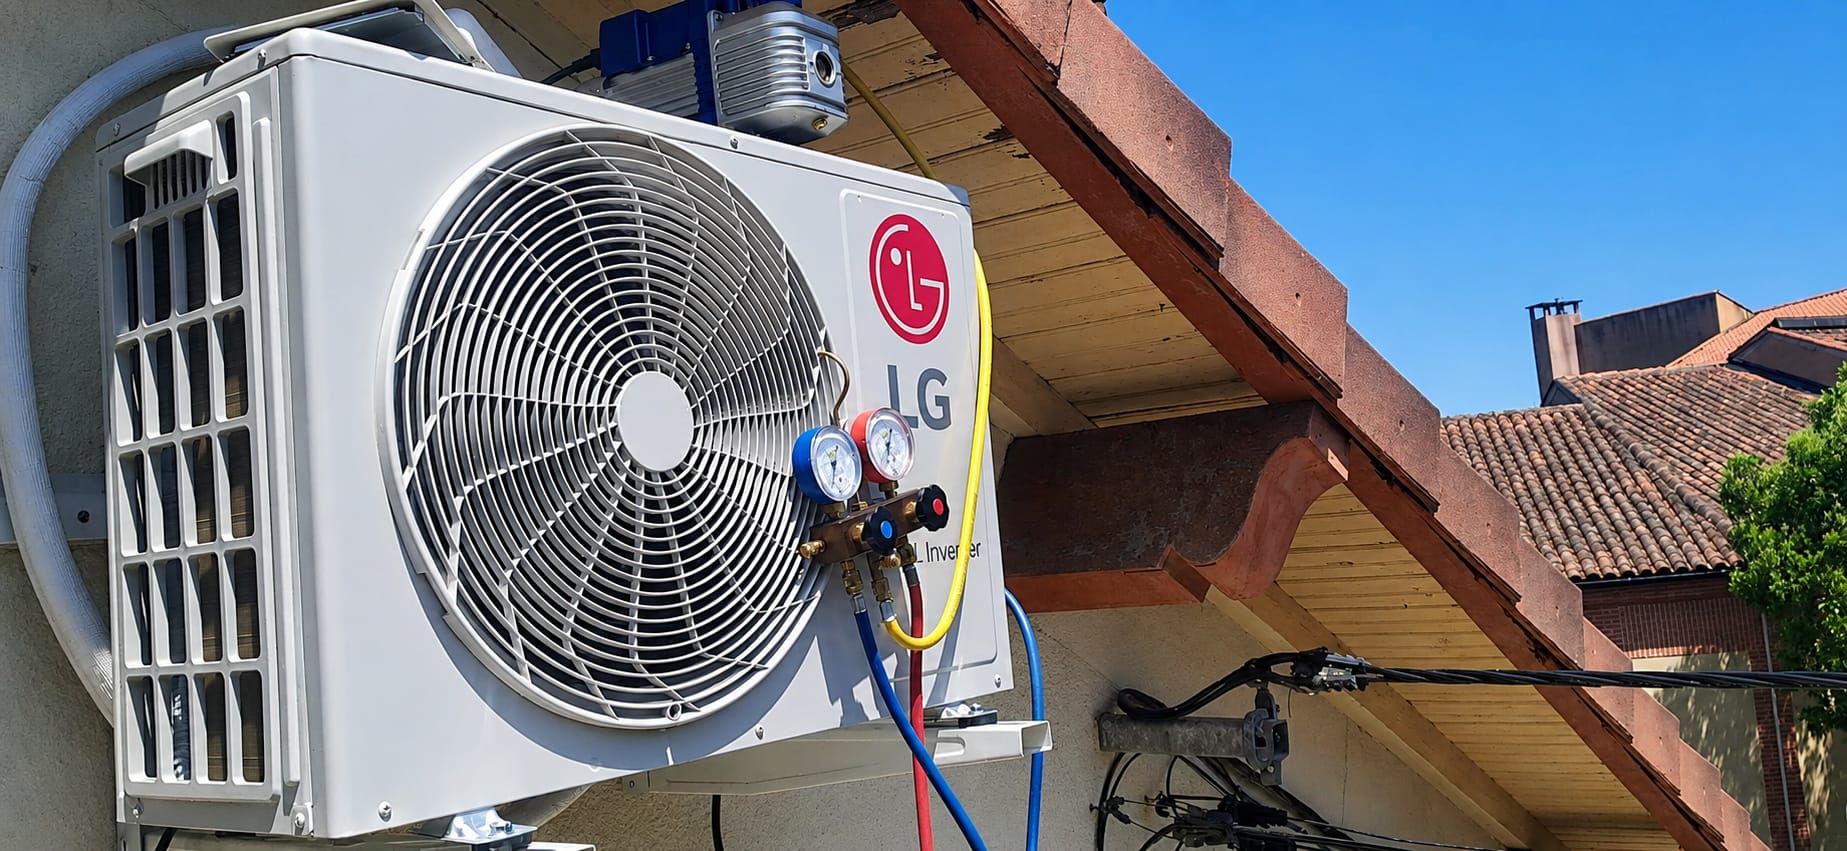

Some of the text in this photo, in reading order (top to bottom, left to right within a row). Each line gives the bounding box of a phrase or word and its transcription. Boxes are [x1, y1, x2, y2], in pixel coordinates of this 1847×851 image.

[875, 223, 945, 336] LG
[887, 364, 952, 431] LG
[925, 541, 982, 563] Inverer
